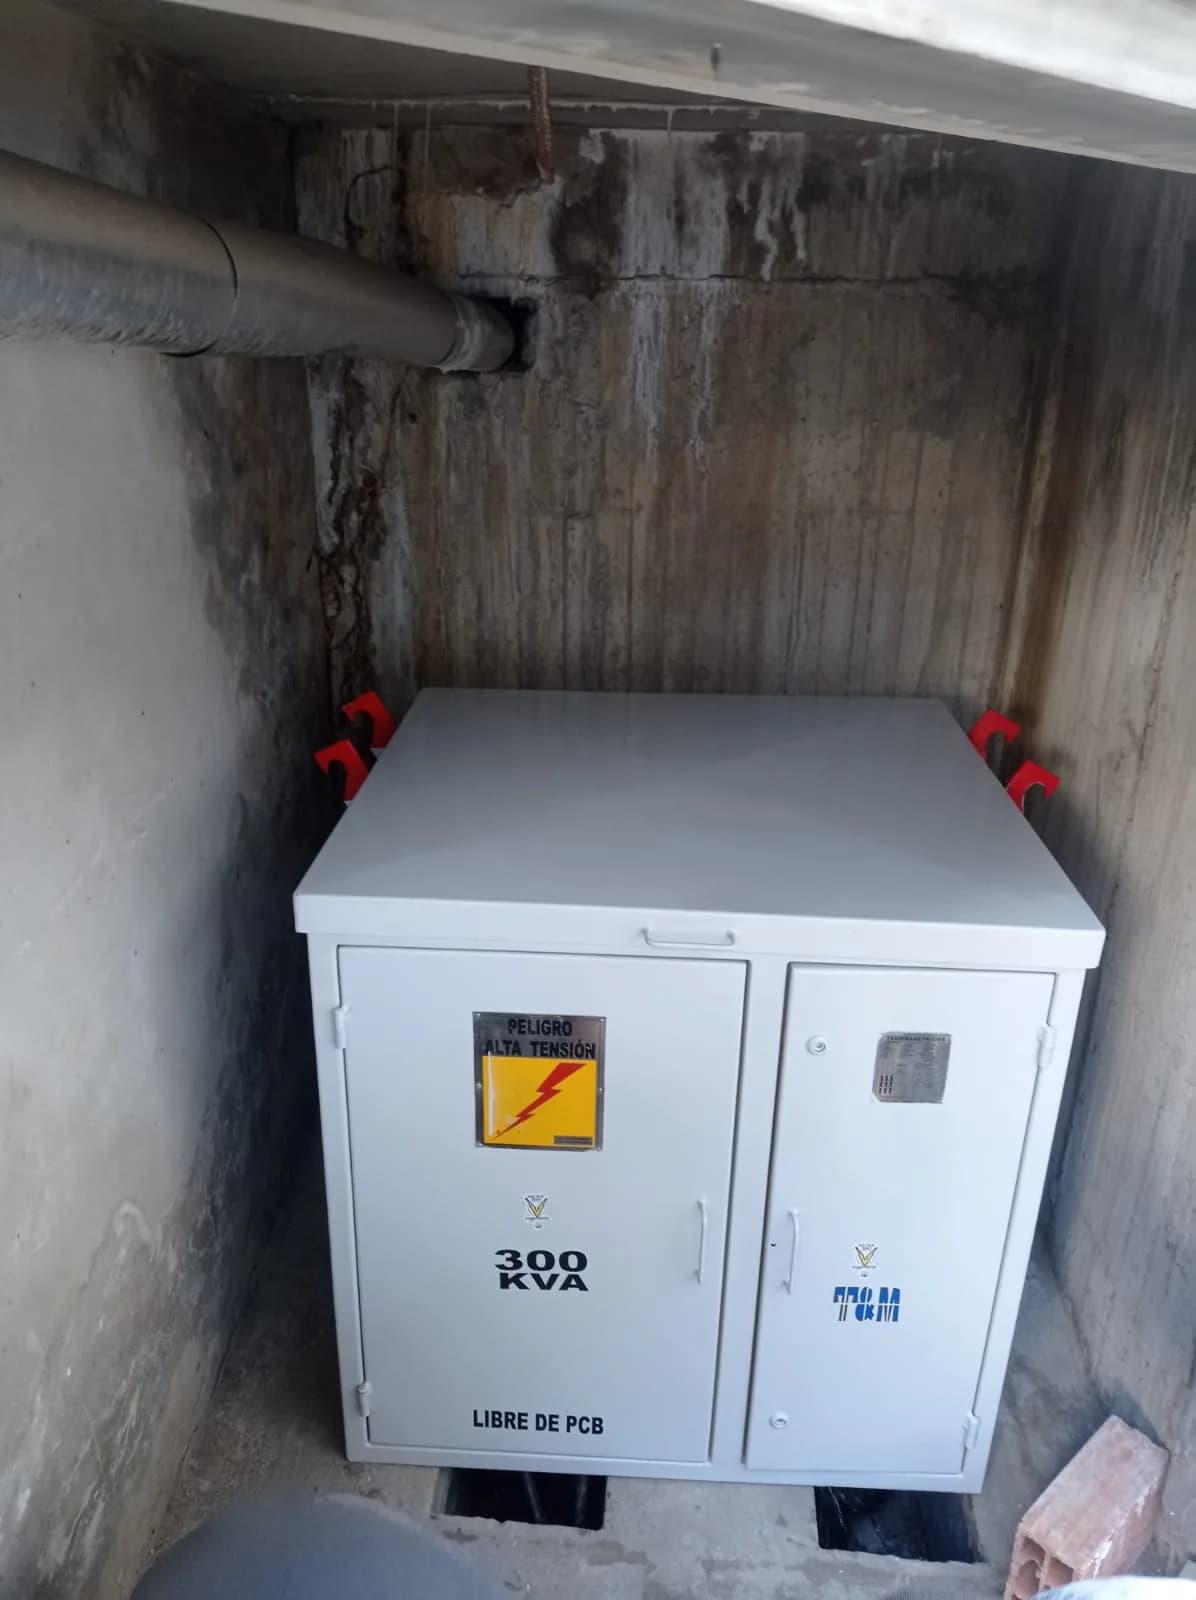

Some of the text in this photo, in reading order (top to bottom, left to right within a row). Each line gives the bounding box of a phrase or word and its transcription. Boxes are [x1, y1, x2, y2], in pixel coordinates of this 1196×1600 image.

[507, 1018, 573, 1037] PELIGRO
[484, 1039, 596, 1060] ALTA TENSIÓN
[494, 1249, 588, 1272] 300
[499, 1272, 589, 1292] KVA
[473, 1409, 604, 1435] LIBRE DE PCB
